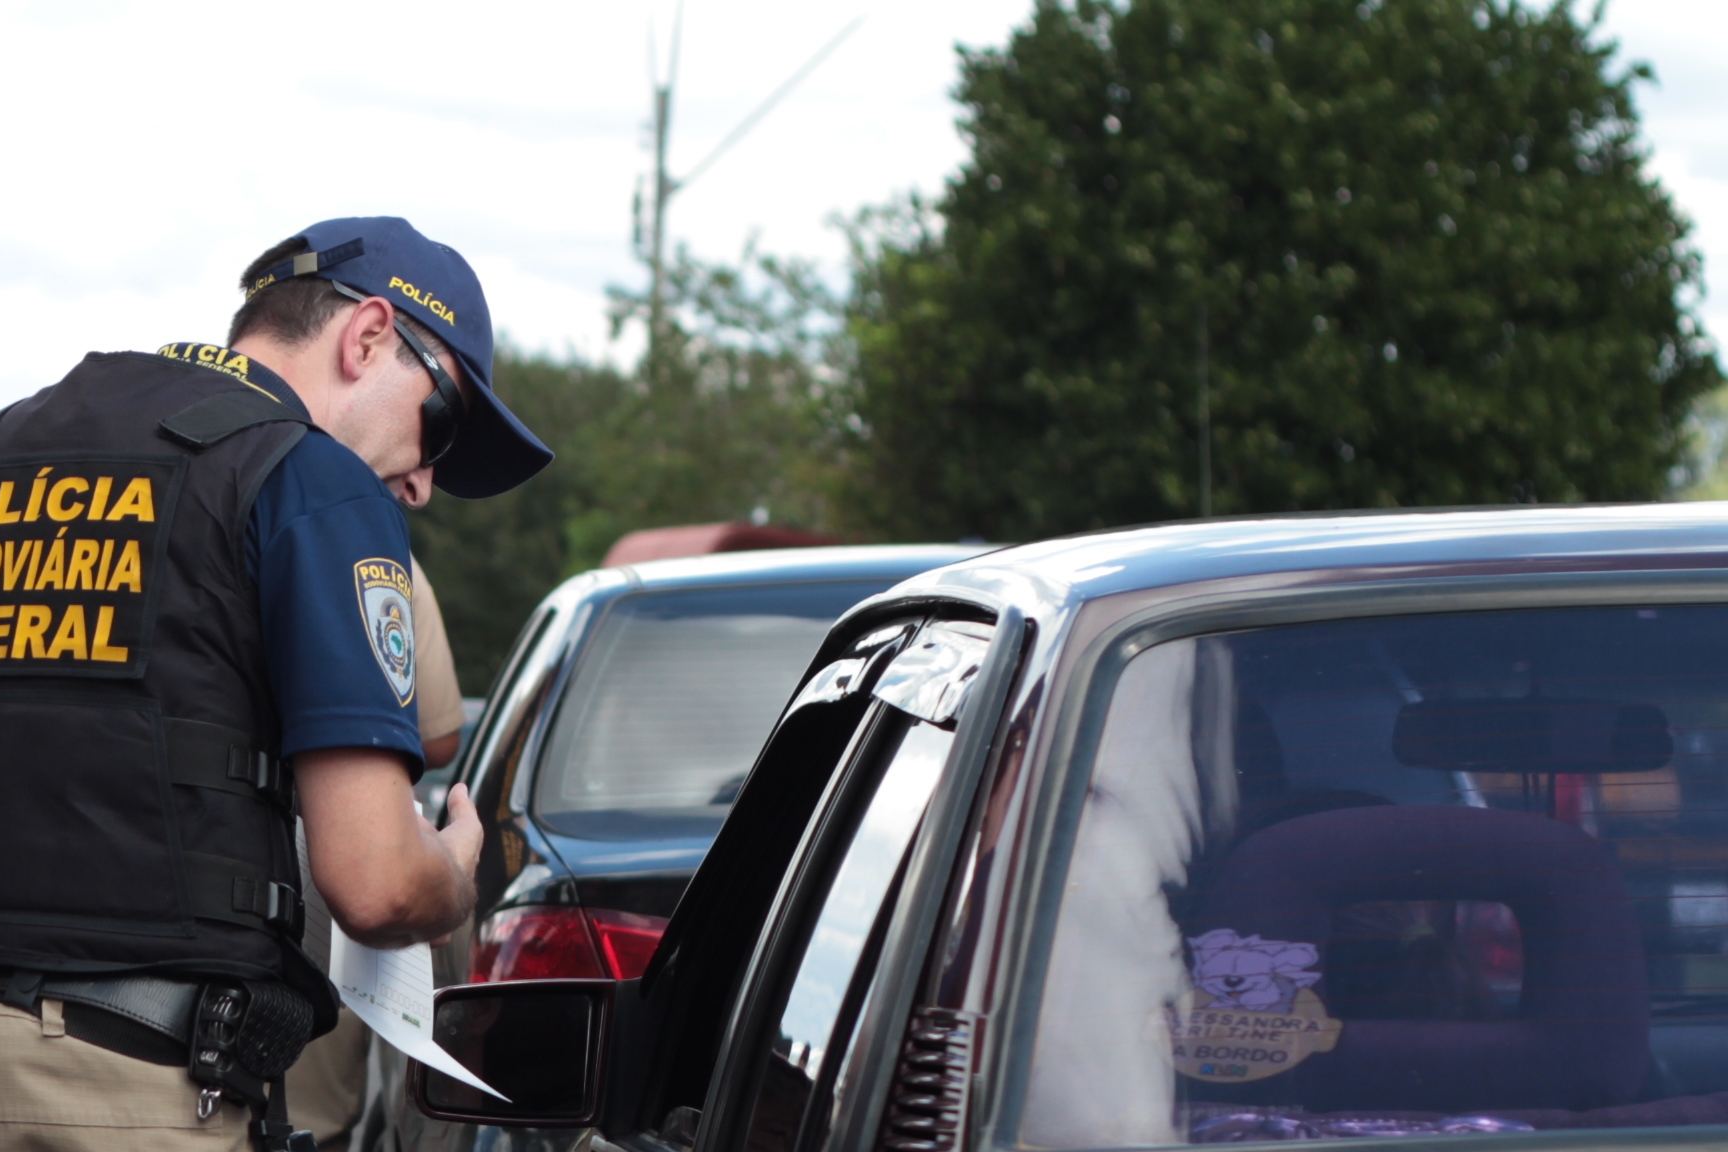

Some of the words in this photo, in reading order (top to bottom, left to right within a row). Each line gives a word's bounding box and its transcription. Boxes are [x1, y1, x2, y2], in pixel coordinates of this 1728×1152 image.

[245, 273, 276, 299] OLÍCIA
[388, 276, 456, 326] POLÍCIA
[157, 343, 249, 375] OLÍCIA
[359, 564, 411, 598] POLÍCIA
[1161, 1009, 1320, 1031] LESSANDRA
[1195, 1045, 1289, 1063] BORDO
